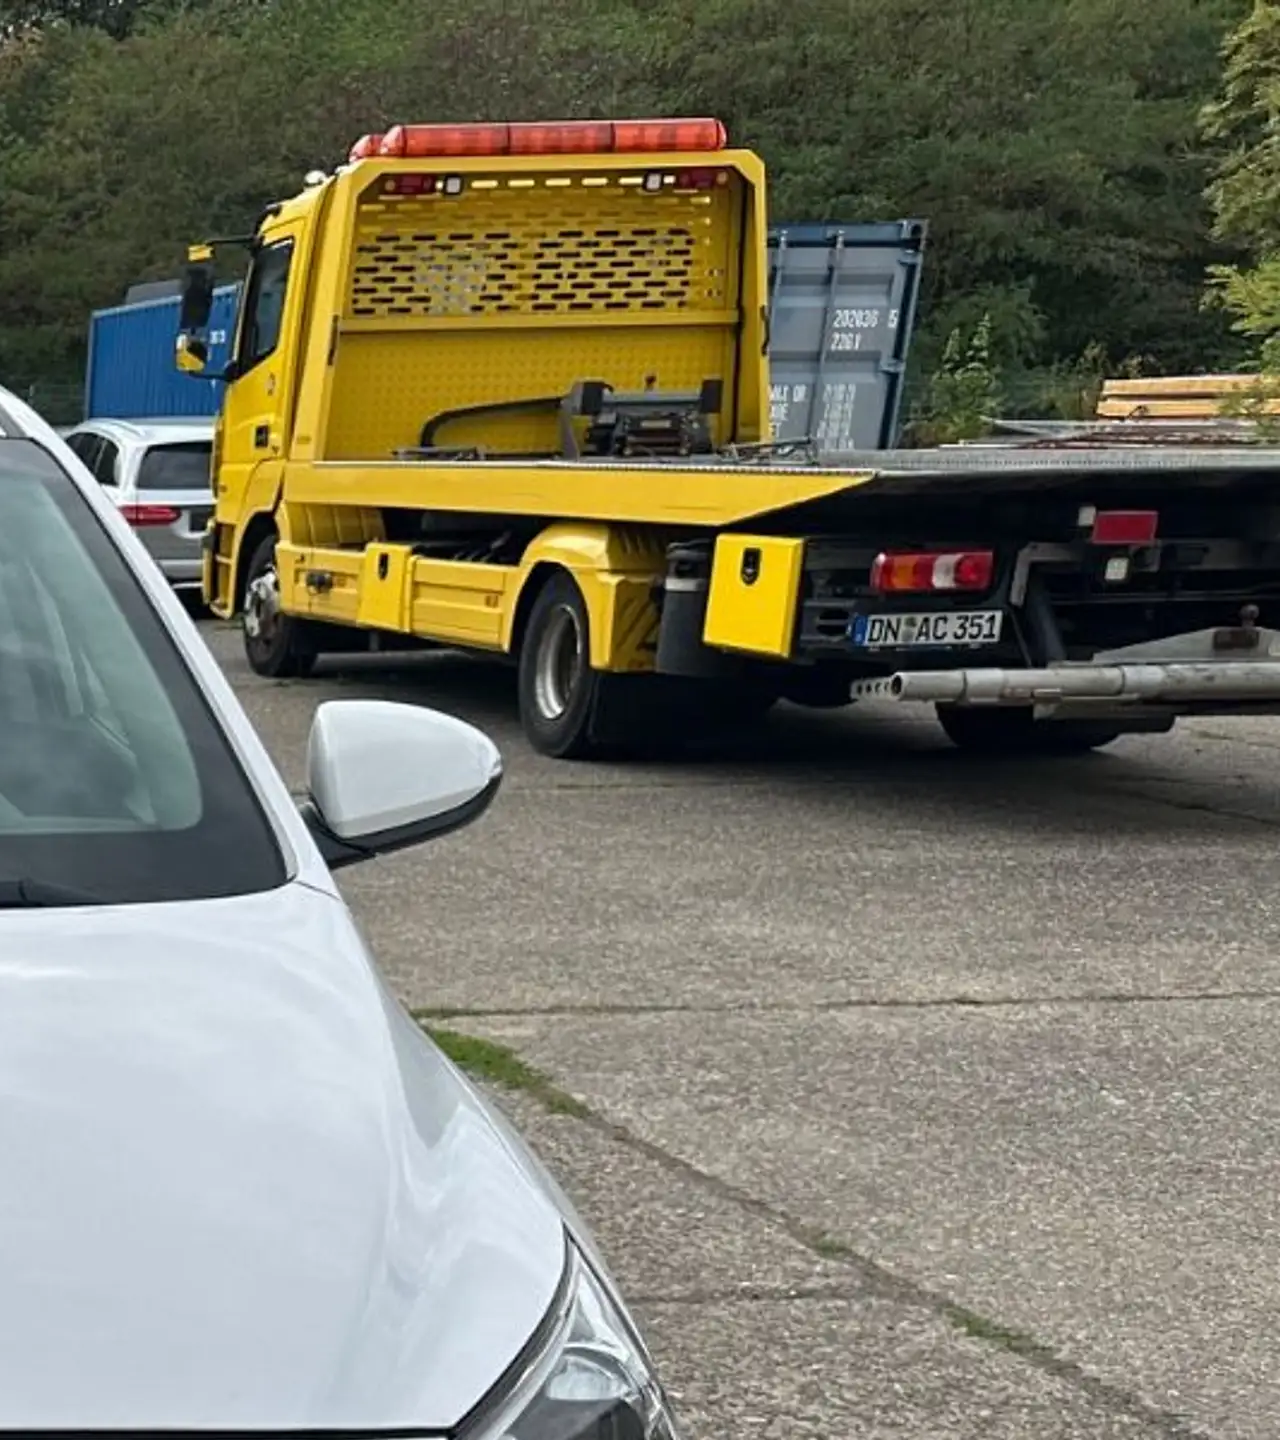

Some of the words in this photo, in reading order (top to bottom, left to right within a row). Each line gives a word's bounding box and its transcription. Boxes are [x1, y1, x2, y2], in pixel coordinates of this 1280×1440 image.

[867, 617, 902, 642] DN
[915, 615, 949, 640] AC
[953, 613, 997, 639] 351
